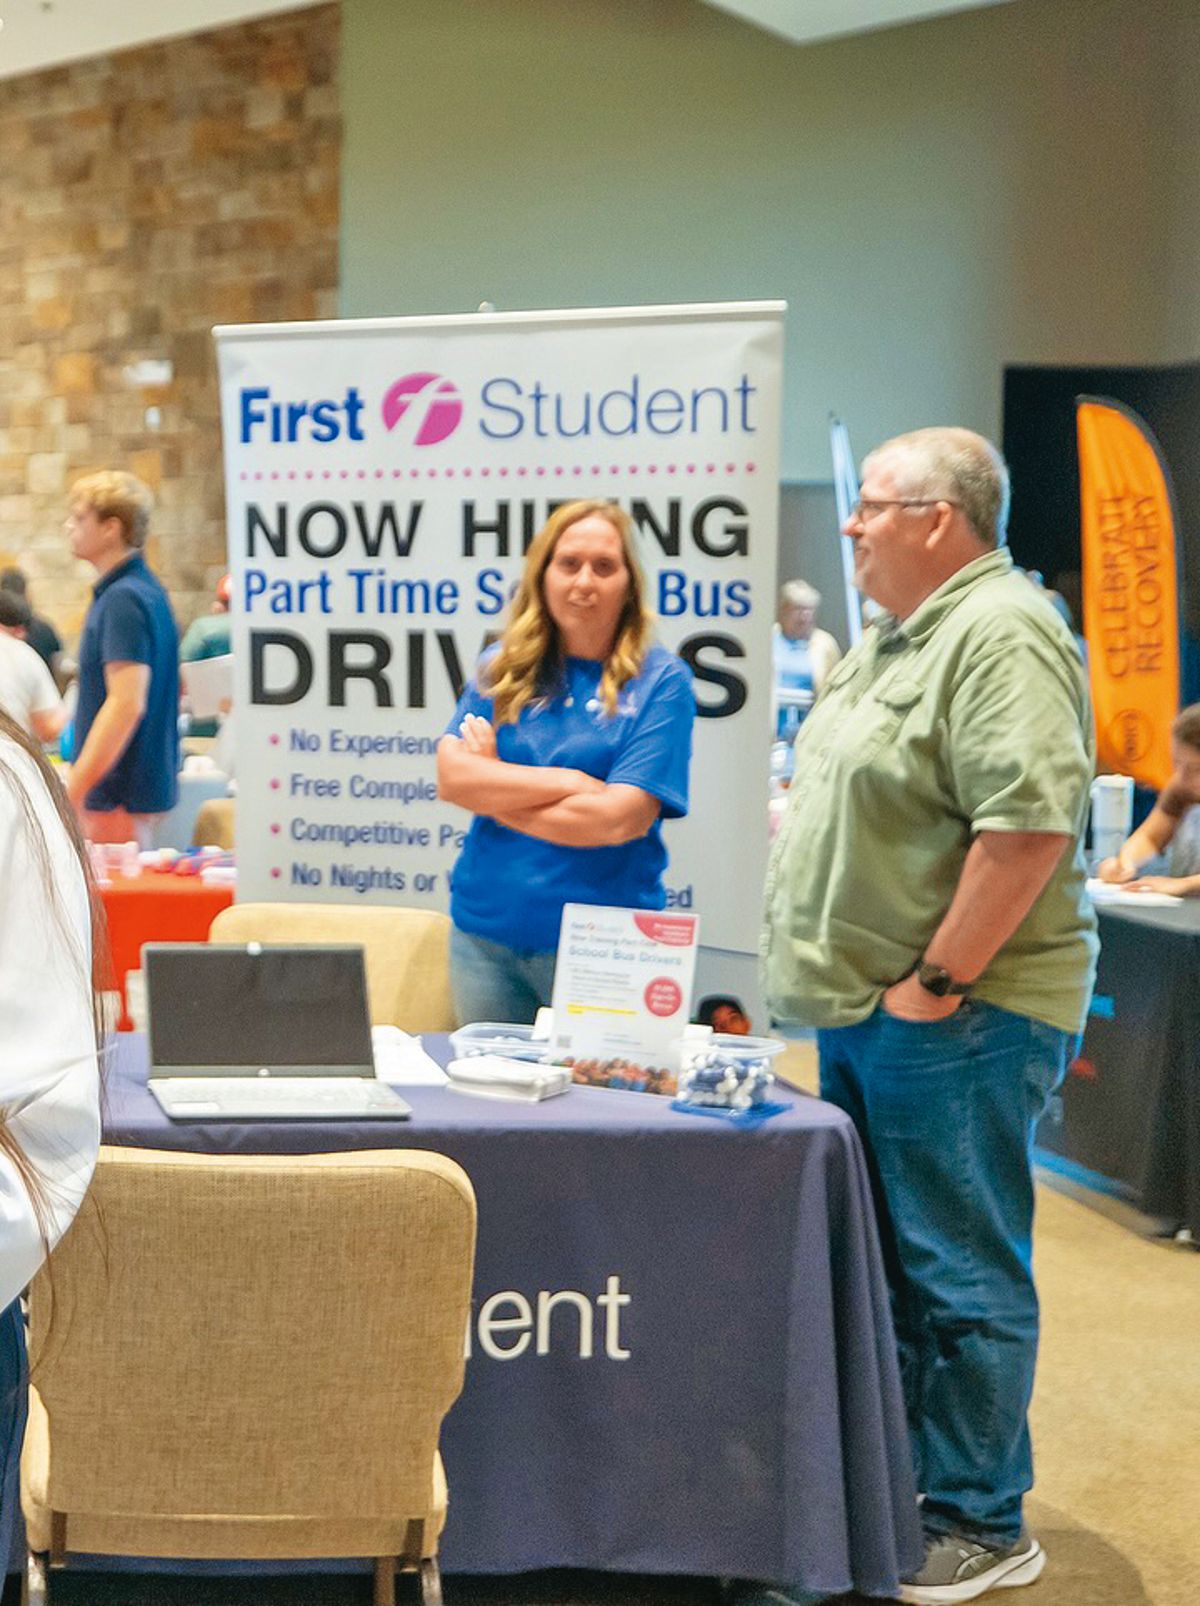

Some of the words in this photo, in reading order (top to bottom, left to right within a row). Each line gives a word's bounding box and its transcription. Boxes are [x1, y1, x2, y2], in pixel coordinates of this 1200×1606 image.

[239, 386, 366, 444] First
[479, 373, 758, 440] Student
[246, 499, 424, 559] NOW
[461, 494, 749, 558] HING
[244, 568, 333, 615] Part
[347, 568, 459, 615] Time
[658, 568, 753, 617] Bus
[1134, 494, 1163, 674] RECOVERY
[249, 628, 748, 718] DRIVS
[290, 730, 320, 752] No
[290, 774, 340, 798] Free
[350, 775, 437, 805] Comple
[291, 818, 430, 849] Competitive
[439, 823, 467, 849] Pa
[291, 863, 322, 887] No
[331, 864, 406, 894] Nights
[414, 872, 437, 893] or
[666, 884, 692, 908] ed
[464, 1275, 632, 1361] ent
